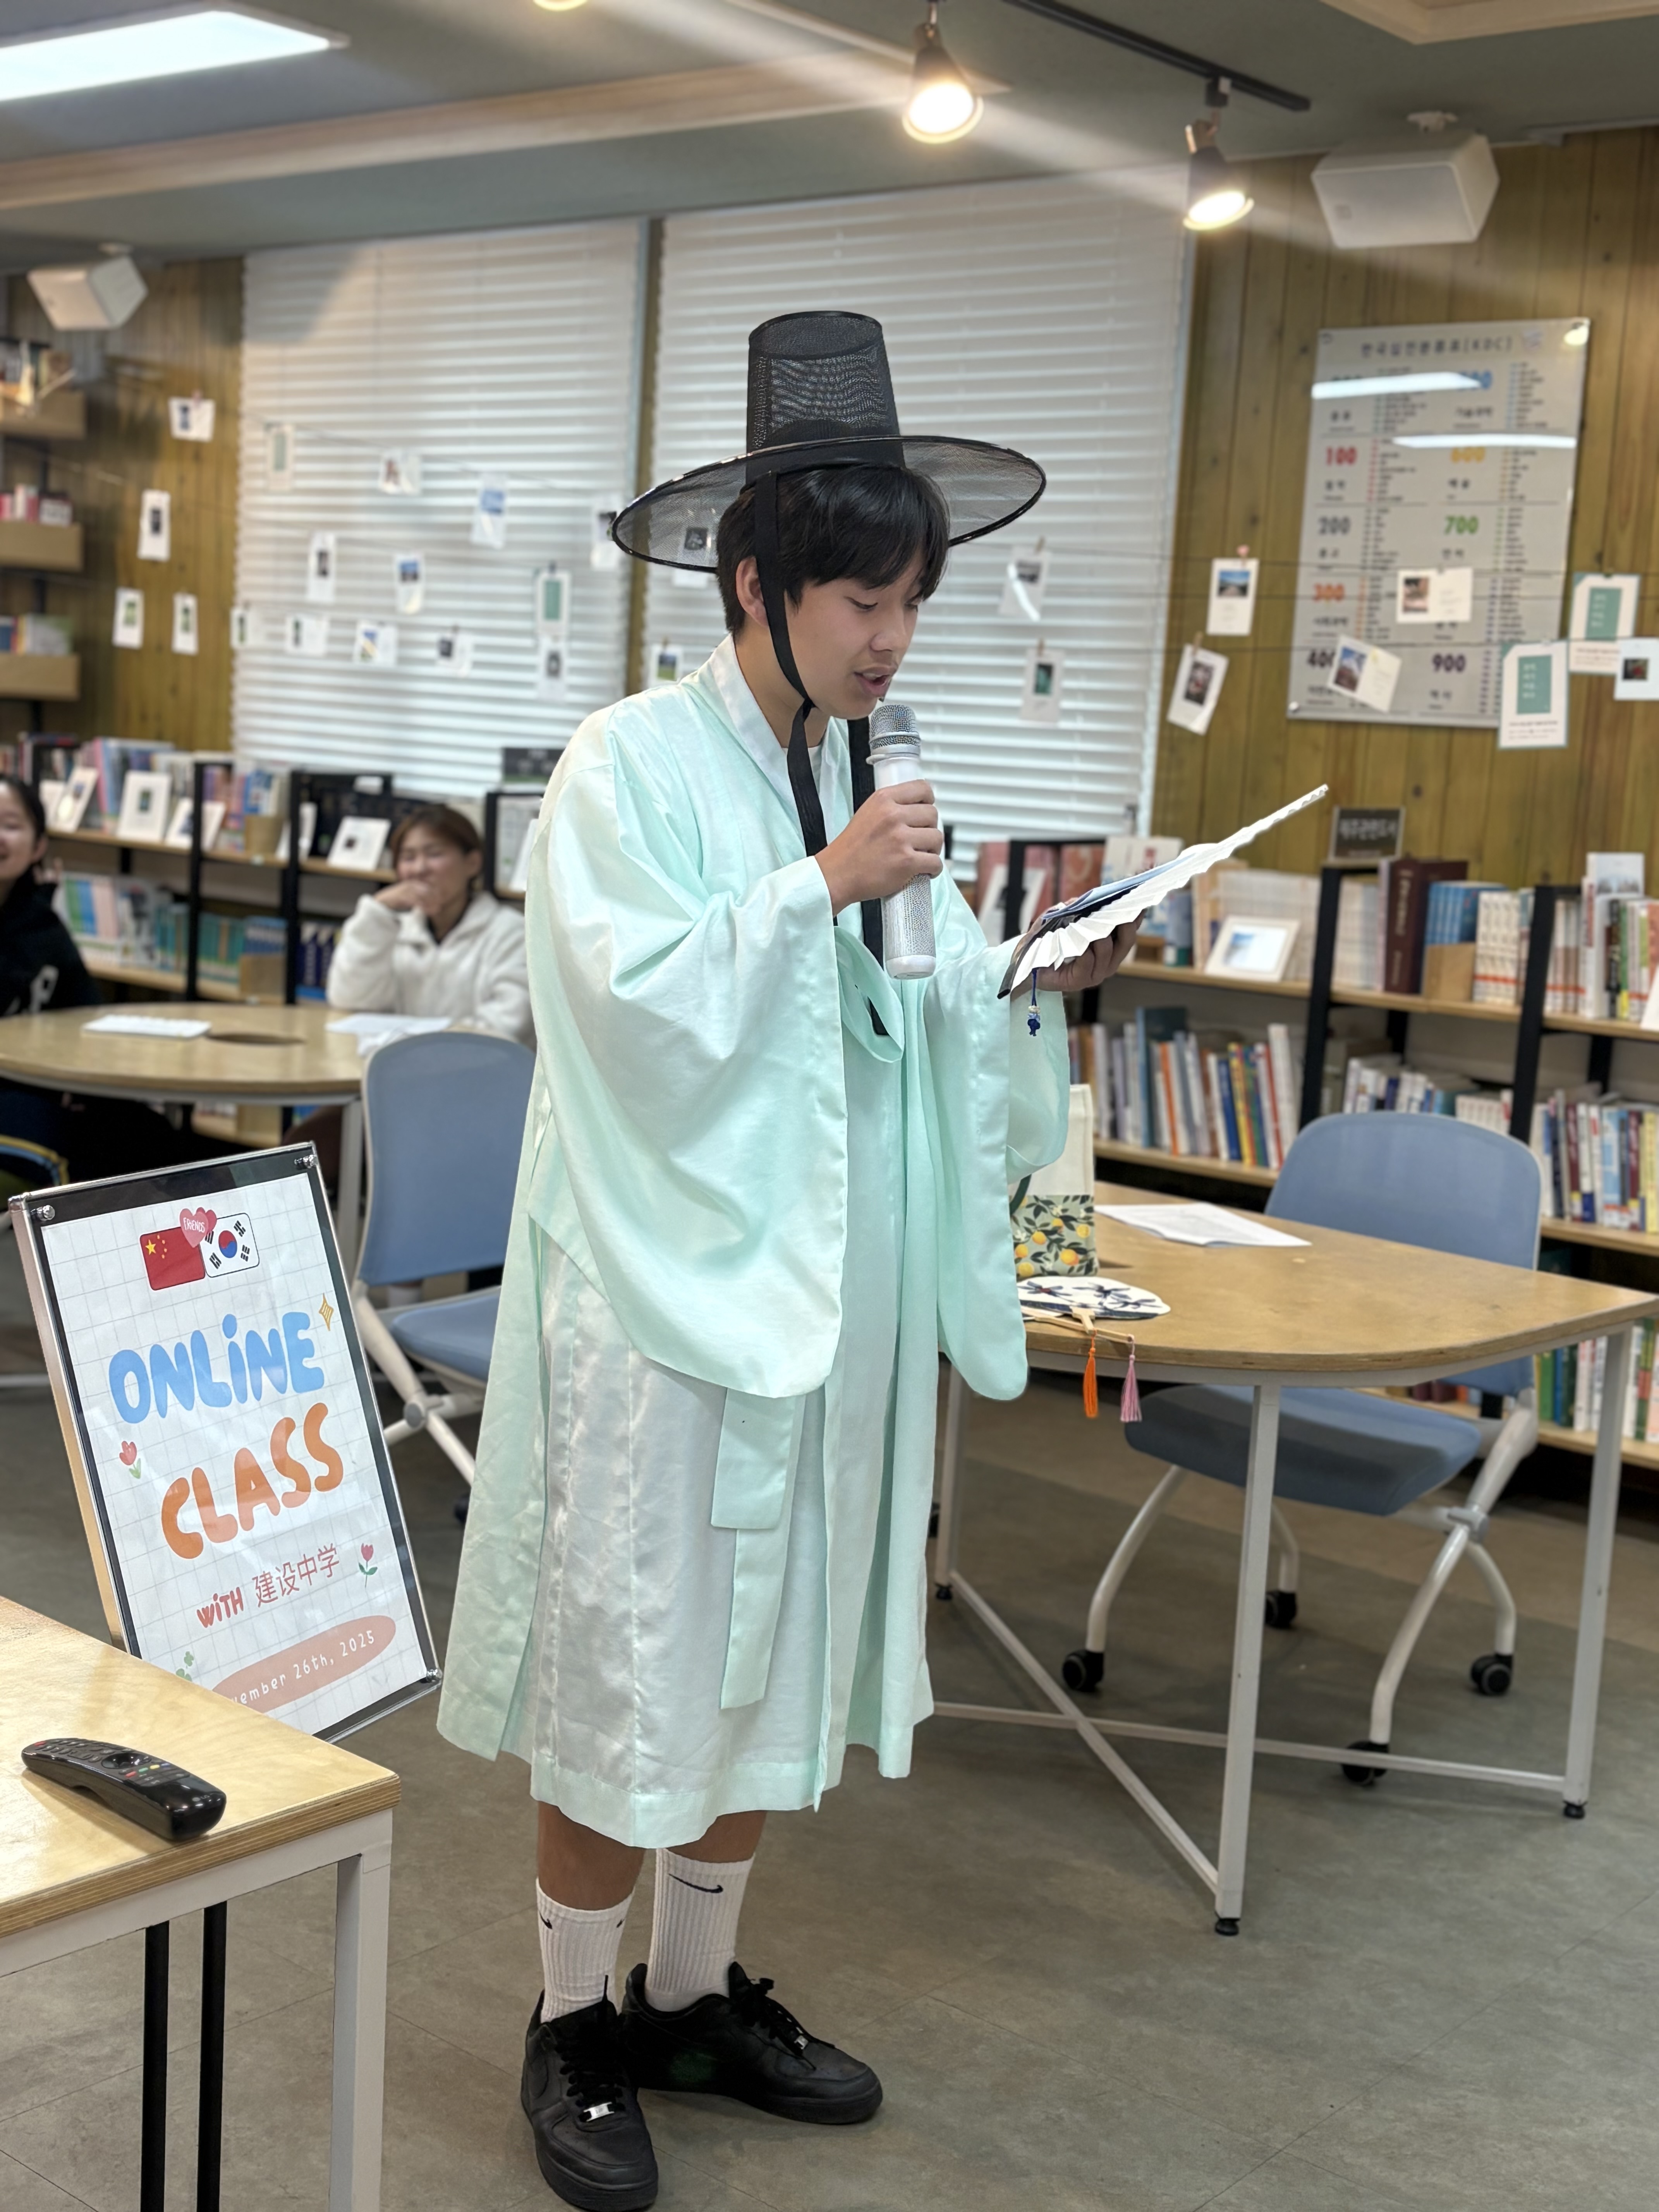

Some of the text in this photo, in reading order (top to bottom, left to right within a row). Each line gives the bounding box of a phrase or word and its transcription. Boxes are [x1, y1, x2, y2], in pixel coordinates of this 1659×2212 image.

[1319, 517, 1350, 534] 200
[1444, 516, 1479, 535] 700
[1432, 654, 1466, 672] 900
[161, 1402, 343, 1559] CLASS
[252, 1543, 339, 1607] 建设中学
[232, 1630, 374, 1704] ember 26th, 2025
